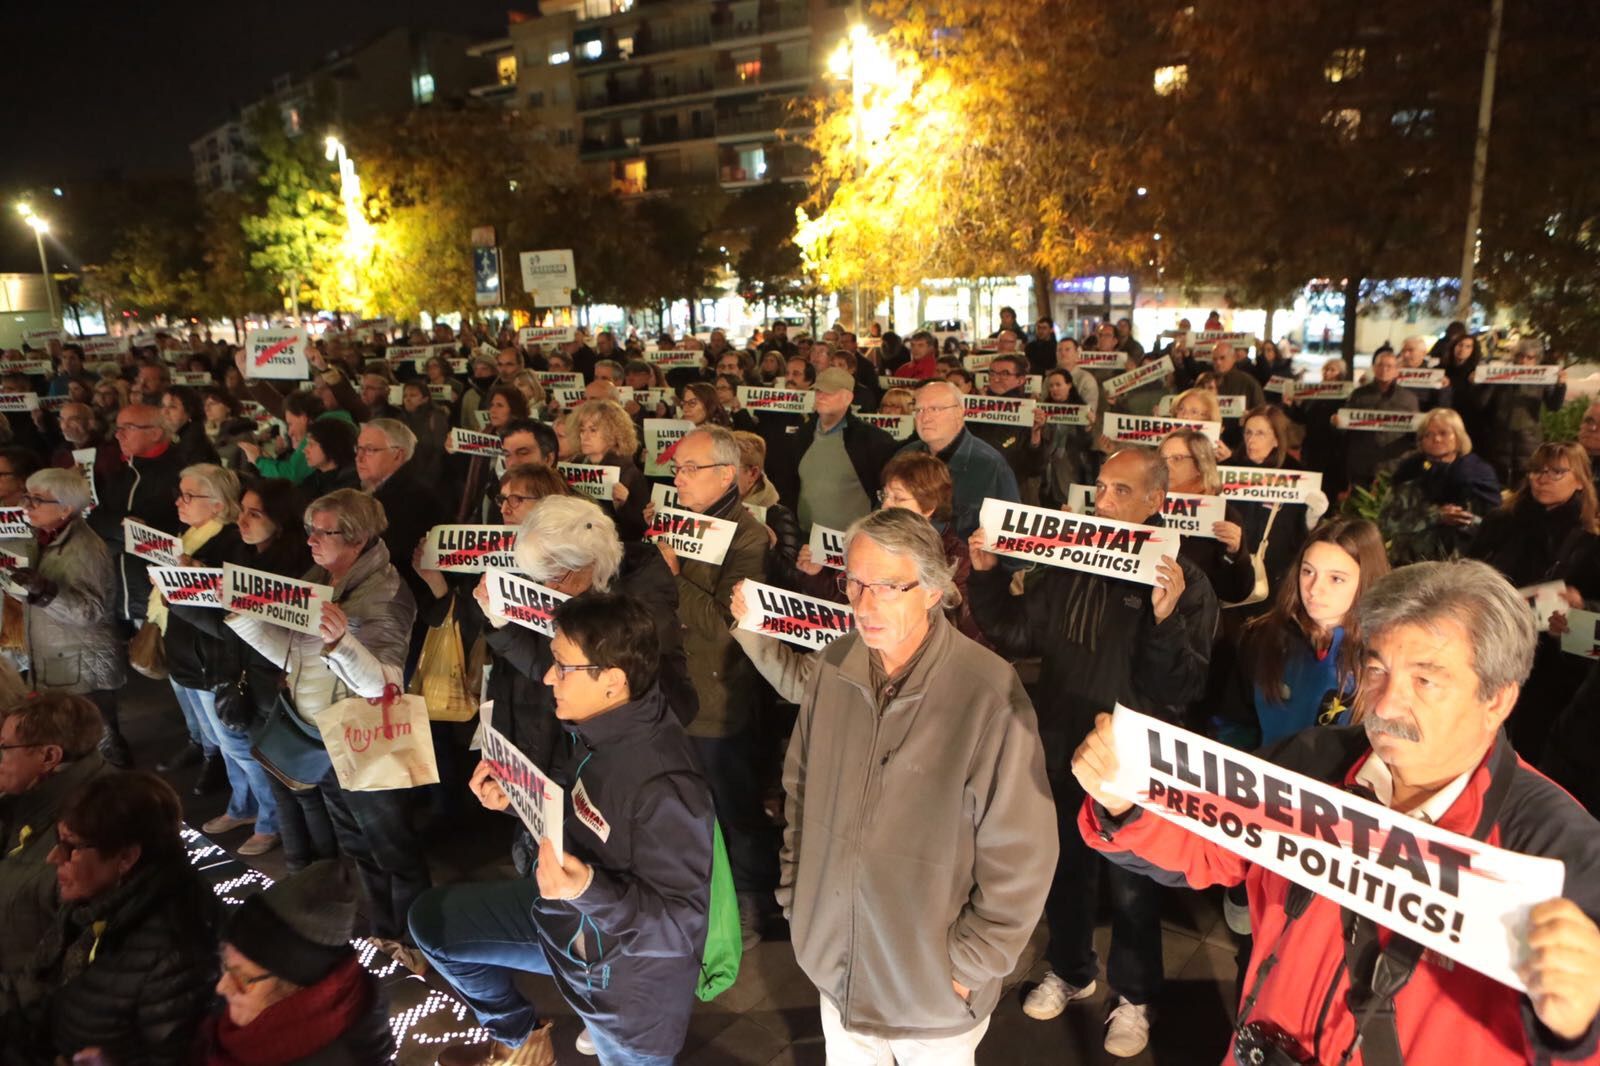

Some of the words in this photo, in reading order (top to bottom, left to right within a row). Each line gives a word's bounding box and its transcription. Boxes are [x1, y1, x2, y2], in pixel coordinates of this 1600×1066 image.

[747, 389, 806, 403] LLIBERTAT
[964, 398, 1020, 413] IBERTAT
[981, 413, 1019, 422] POLÍTICS!
[1219, 471, 1301, 489] IBERTAT
[1243, 487, 1299, 500] POLÍTICS!
[438, 530, 518, 552] LLIBERT
[1001, 508, 1152, 556] LLIBERTAT
[437, 553, 480, 567] PRESOS
[483, 552, 519, 568] POLÍT
[996, 535, 1055, 558] PRESOS
[1060, 547, 1141, 574] POLÍTICS!
[166, 590, 199, 602] PRESOS
[232, 570, 312, 610] LLIBERTAT
[231, 594, 264, 615] PRESOS
[266, 606, 310, 628] POLÍTICS!
[503, 602, 548, 629] PRESOS
[762, 614, 811, 641] PRESOS
[344, 722, 412, 753] Anyrm
[510, 784, 545, 837] POLÍTICS!
[1147, 728, 1471, 898] LLIBERTAT
[1149, 777, 1263, 849] PRESOS
[1276, 834, 1465, 944] POLÍTICS!
